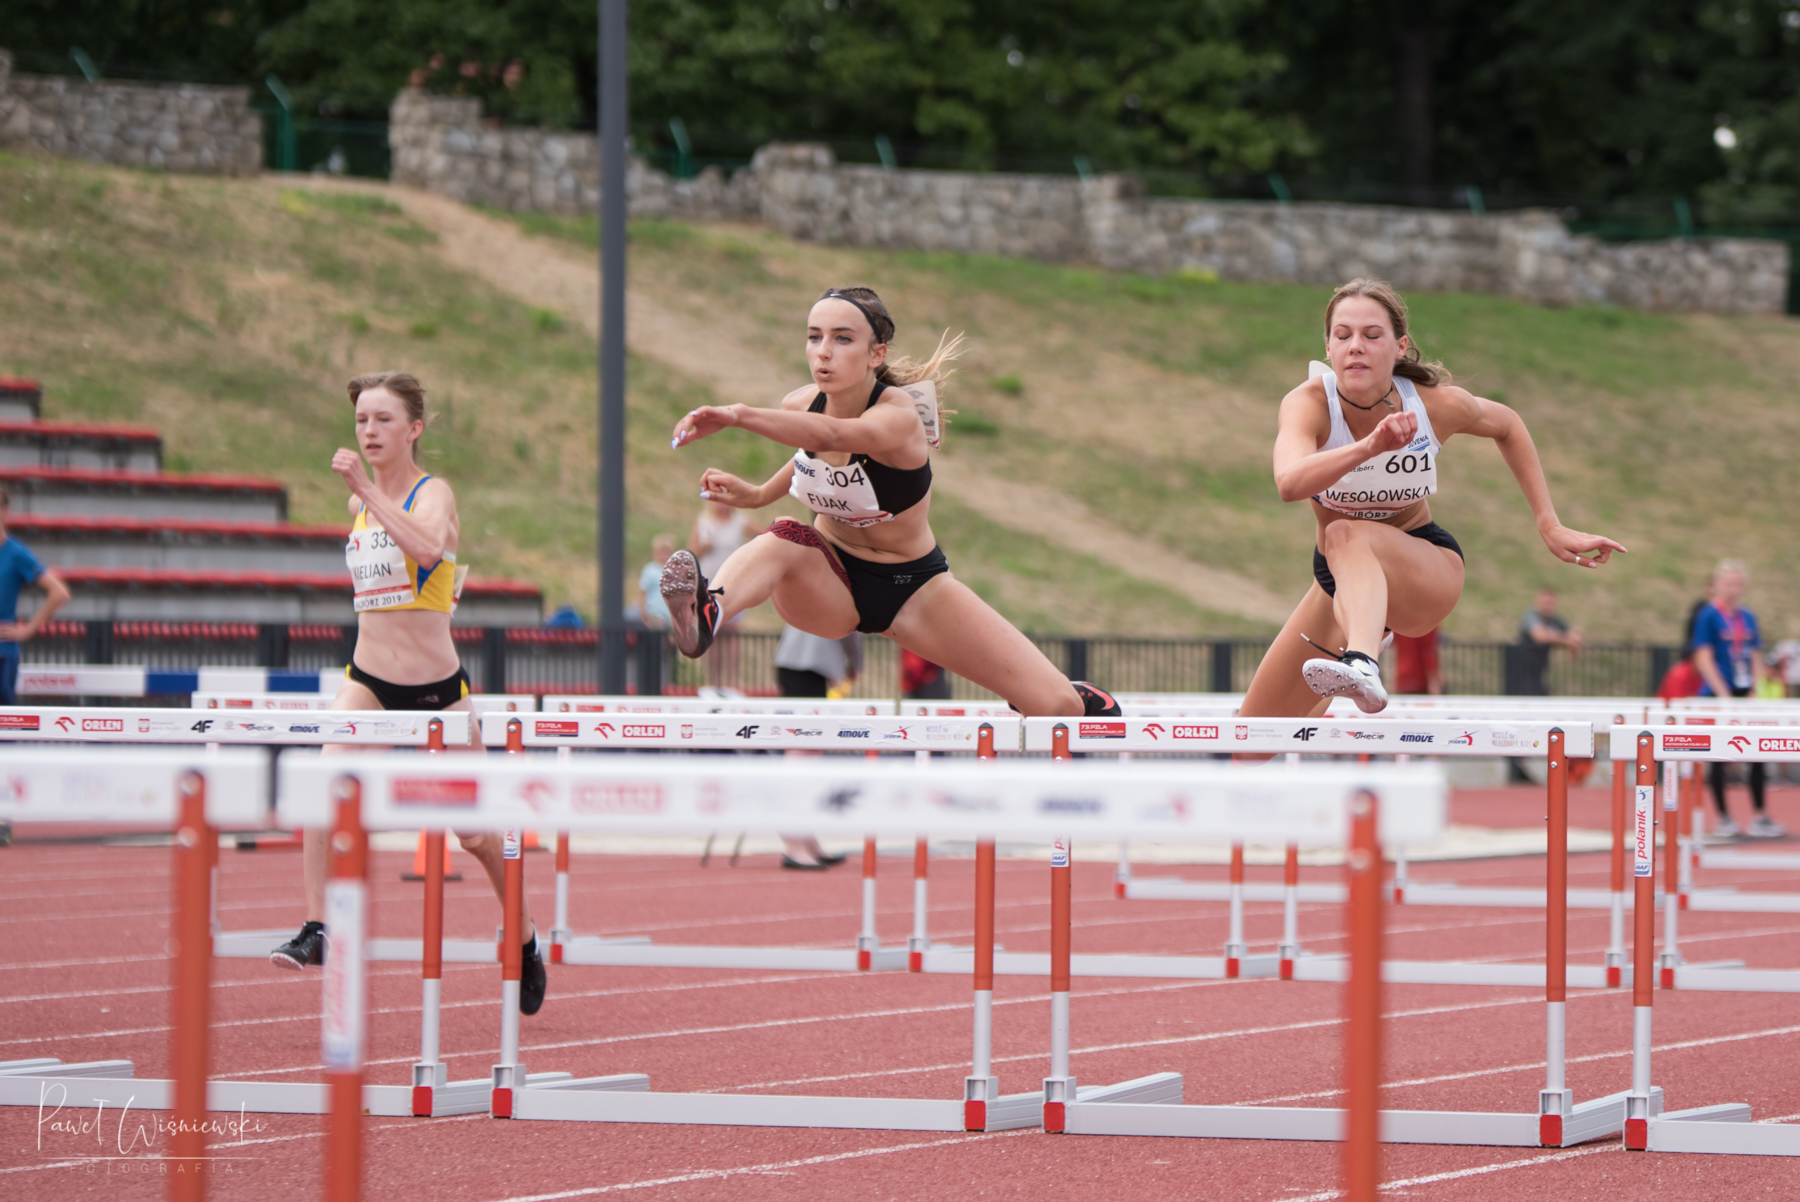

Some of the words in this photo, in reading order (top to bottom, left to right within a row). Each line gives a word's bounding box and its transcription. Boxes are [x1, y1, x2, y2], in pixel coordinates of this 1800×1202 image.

[1352, 464, 1375, 473] cibórz
[1385, 452, 1432, 474] 601
[825, 467, 865, 488] 304
[1325, 485, 1431, 503] WESOŁOWSKA
[807, 492, 853, 513] FIJAK
[381, 594, 402, 606] 2019
[83, 720, 121, 731] ORLEN
[191, 719, 214, 733] 4F
[623, 726, 664, 737] ORLEN
[735, 725, 760, 739] 4F
[1174, 727, 1217, 738] ORLEN
[1293, 727, 1319, 741] 4F
[1399, 734, 1434, 743] 4MOVE
[1760, 740, 1800, 751] ORLEN
[1636, 808, 1648, 860] polanik
